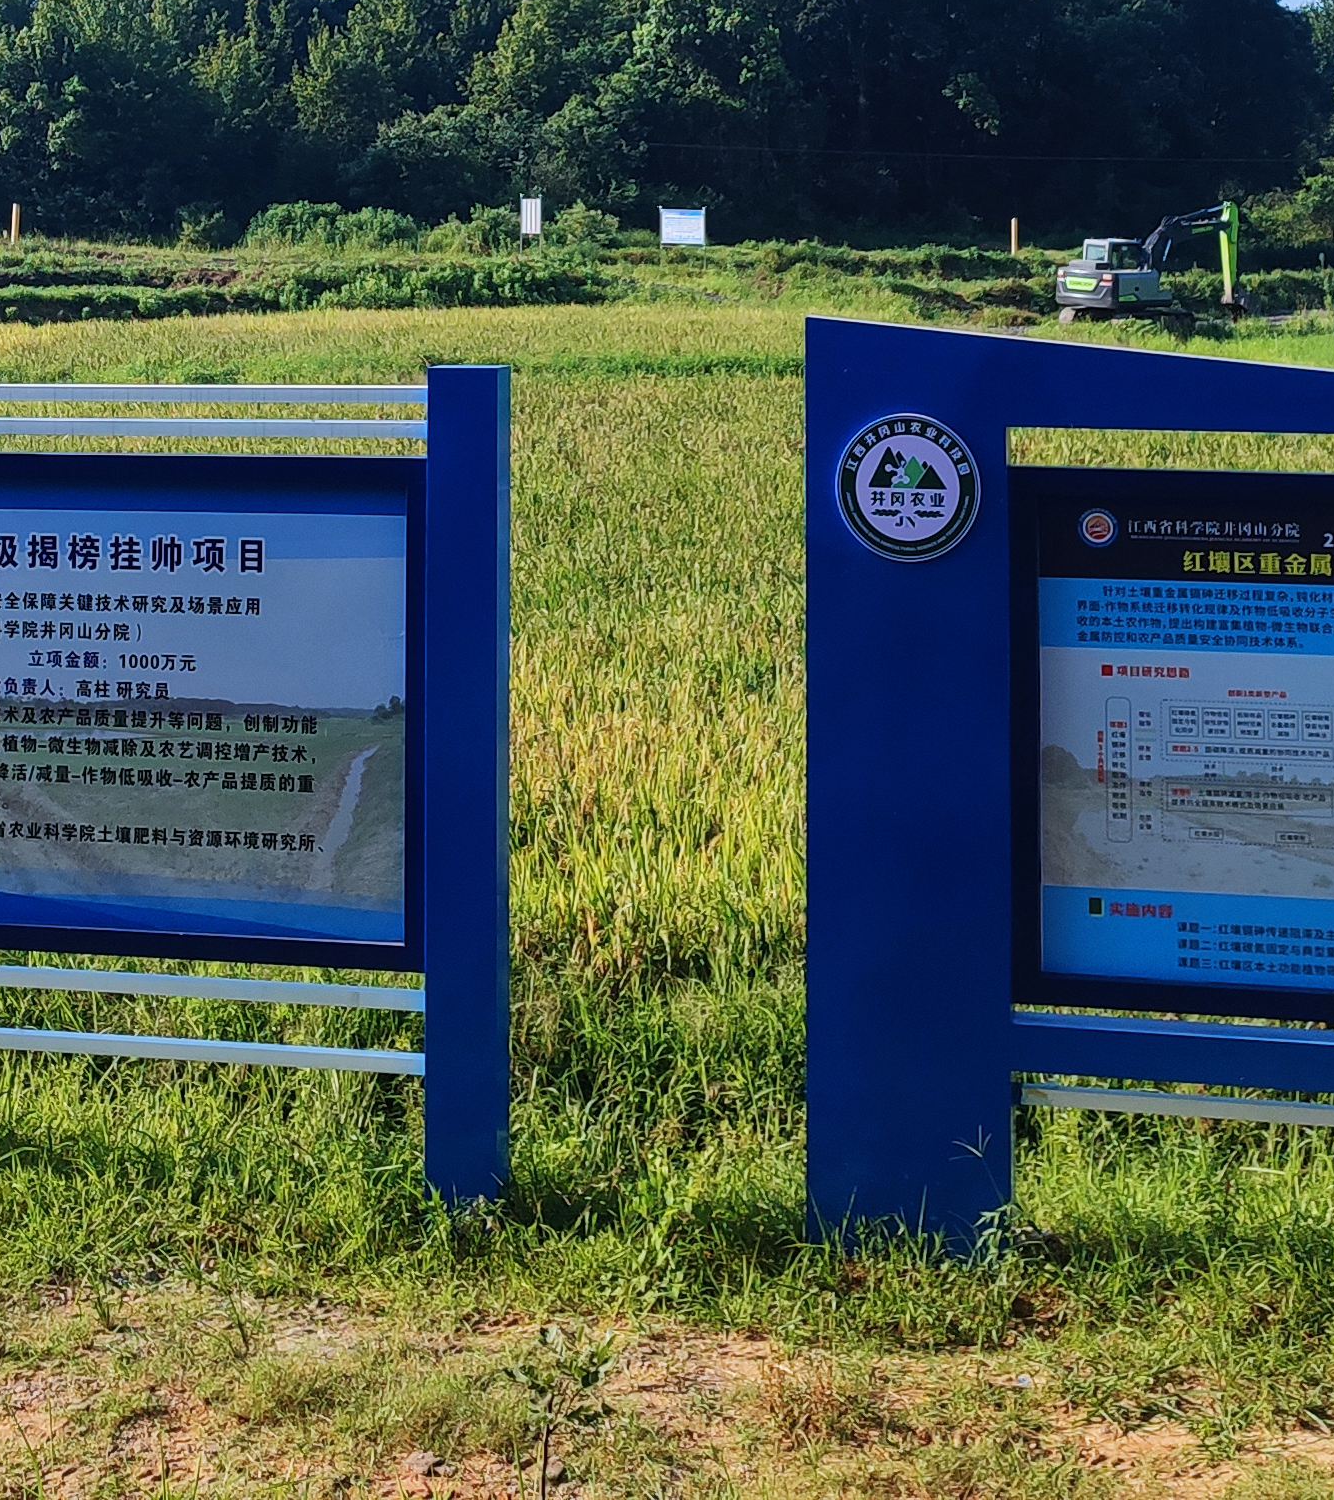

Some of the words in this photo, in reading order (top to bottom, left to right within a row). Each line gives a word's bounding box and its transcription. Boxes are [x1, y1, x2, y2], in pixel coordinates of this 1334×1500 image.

[870, 491, 945, 507] 井冈农业
[28, 650, 197, 673] 立项金额：1000万元
[1116, 665, 1190, 678] 项目研究思路
[116, 680, 170, 701] 研究员
[1109, 902, 1174, 919] 实施内容
